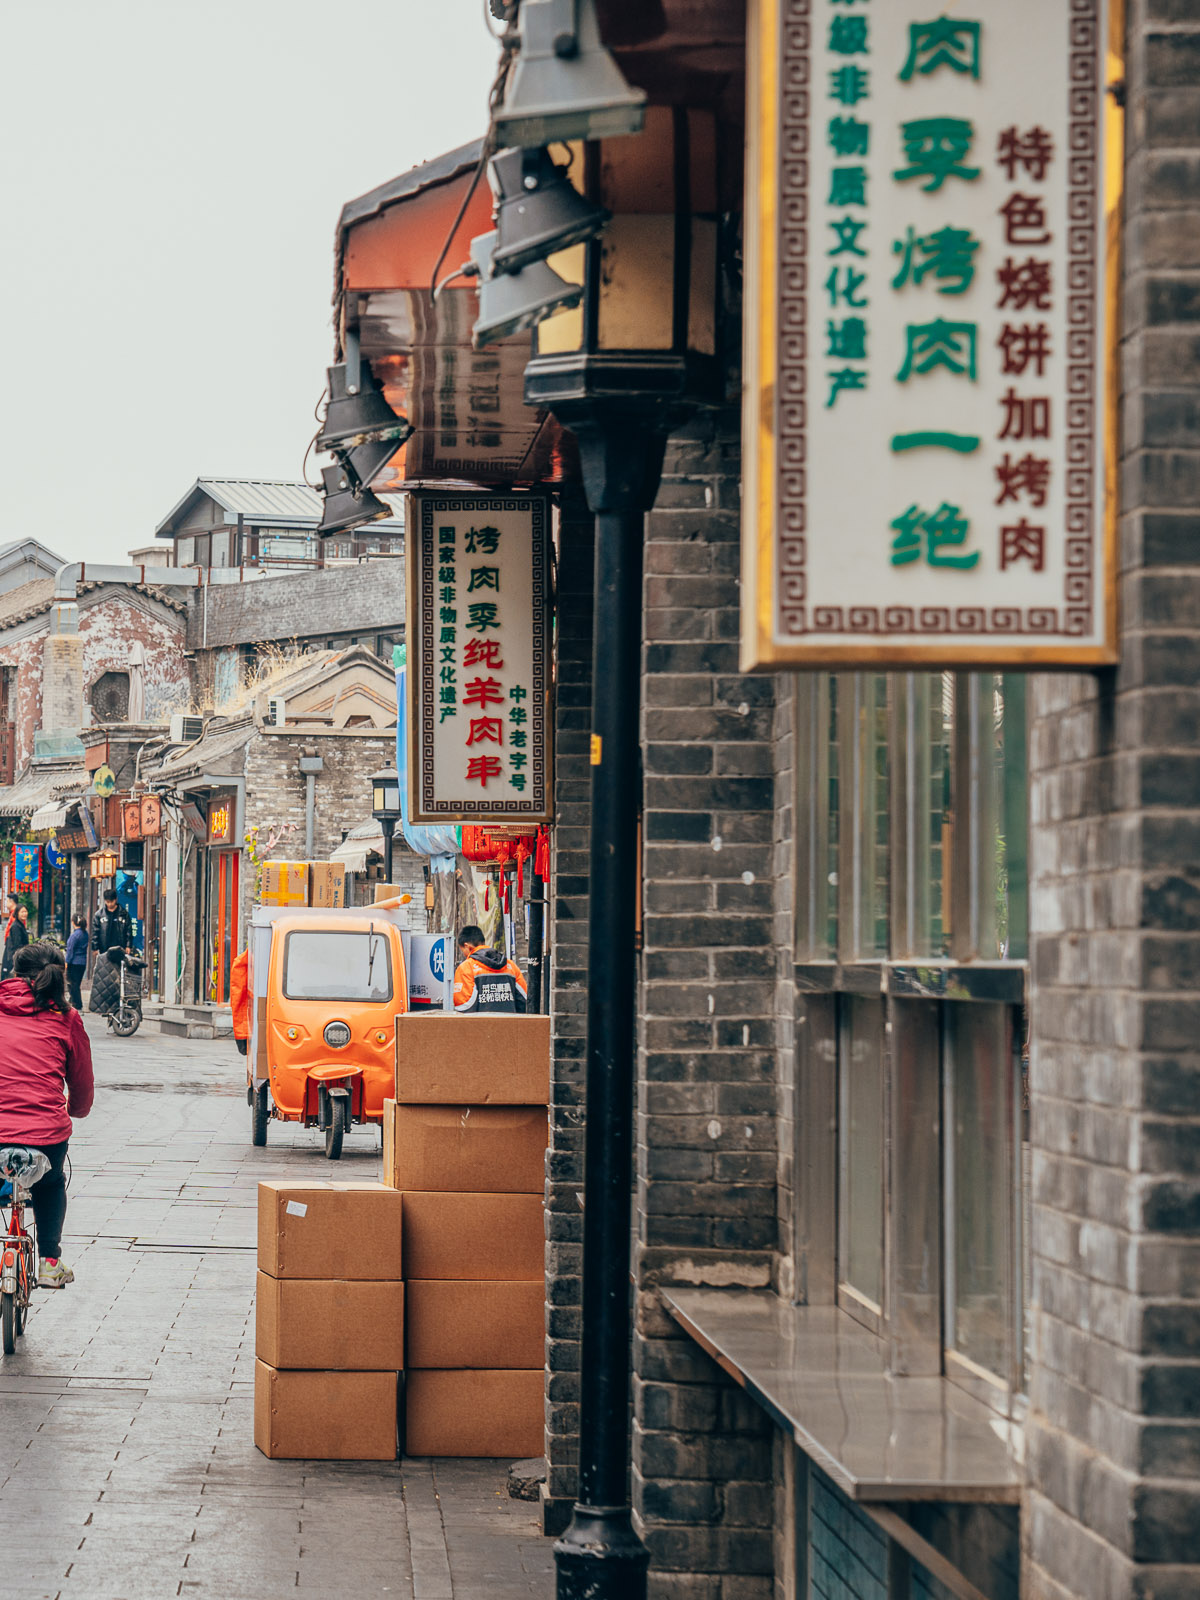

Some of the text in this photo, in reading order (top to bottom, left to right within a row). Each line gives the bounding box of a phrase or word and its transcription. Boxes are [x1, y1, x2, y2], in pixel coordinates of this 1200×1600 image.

[824, 0, 872, 409] 级非物质文化遗产
[996, 125, 1053, 574] 特色烧饼加烤肉
[438, 526, 456, 723] 国家级非物质文化遗产
[508, 685, 528, 792] 中华老字号
